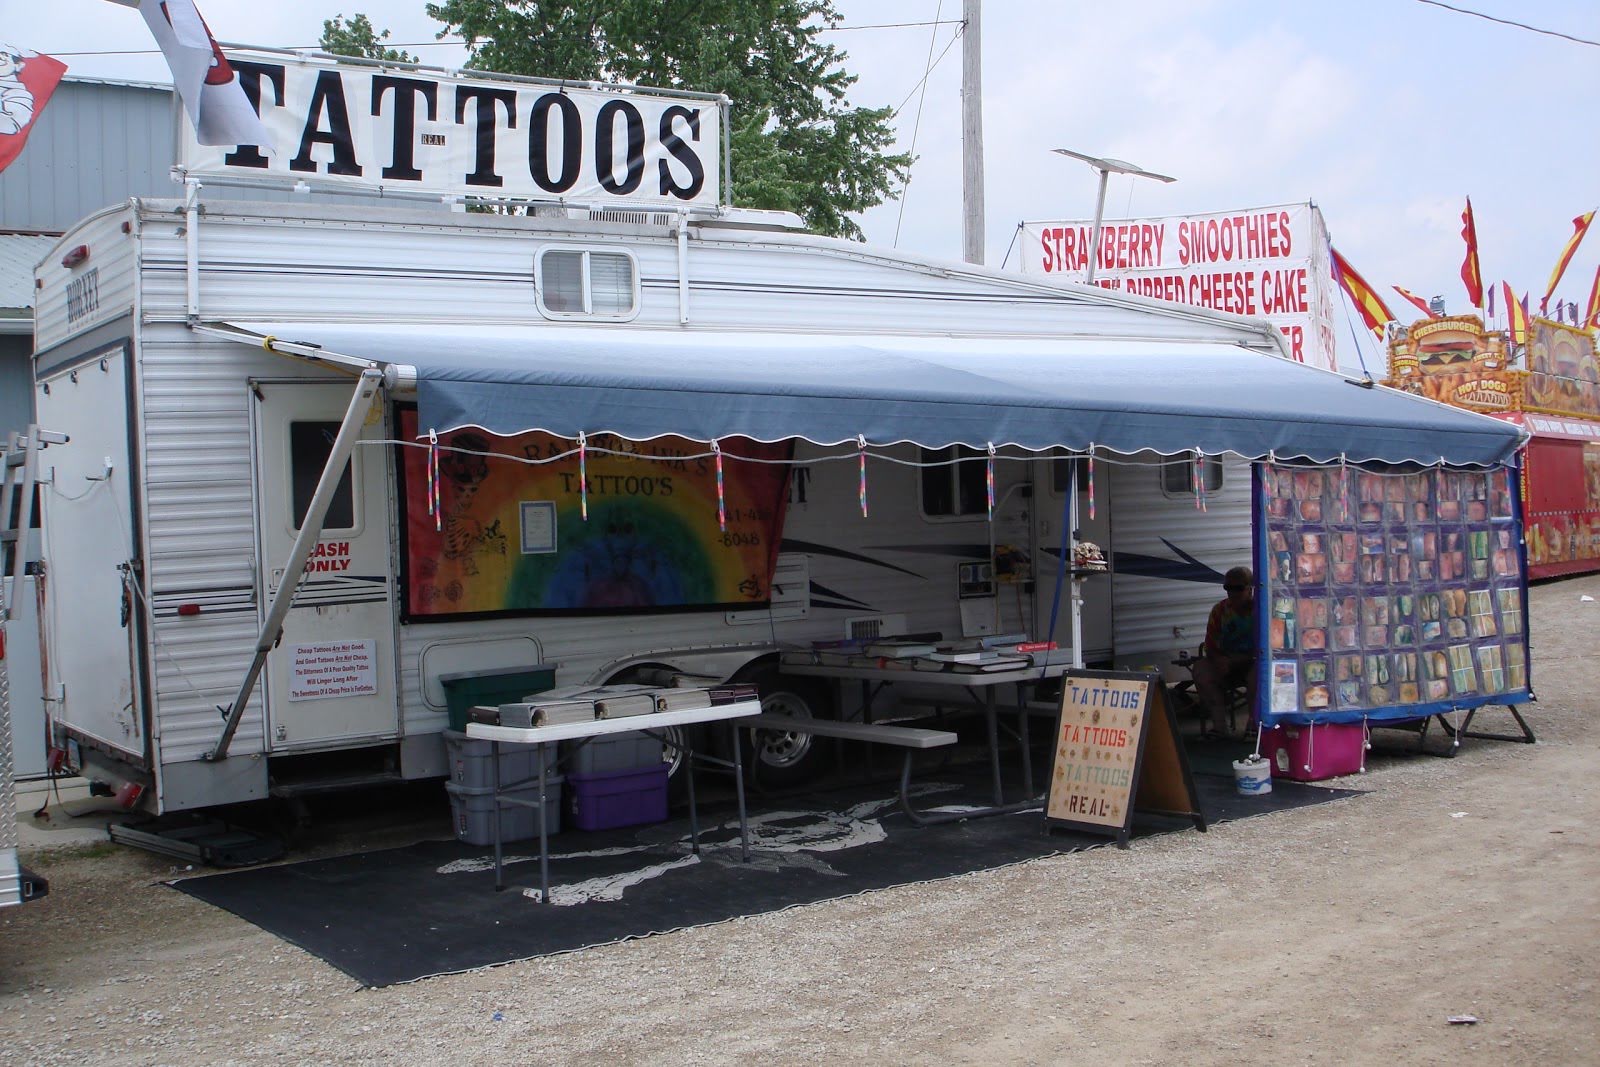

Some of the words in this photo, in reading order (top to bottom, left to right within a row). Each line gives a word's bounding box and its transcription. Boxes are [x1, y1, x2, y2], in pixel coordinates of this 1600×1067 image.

[225, 59, 705, 200] TATTOOS
[421, 134, 446, 146] REAL
[1178, 211, 1291, 265] SMOOTHIES
[1188, 271, 1255, 316] CHEESE
[1261, 268, 1308, 314] CAKE
[1414, 321, 1483, 340] CHEESEBURGERS
[1458, 381, 1478, 396] HOT
[1481, 380, 1507, 392] DOGS
[559, 472, 674, 496] TATTOO'S
[309, 542, 349, 557] ASH
[303, 559, 351, 572] ONLY
[1072, 687, 1140, 709] TATTOOS
[1064, 724, 1127, 747] TATTOOS
[1066, 764, 1129, 787] TATTOOS
[1069, 795, 1107, 817] REAL
